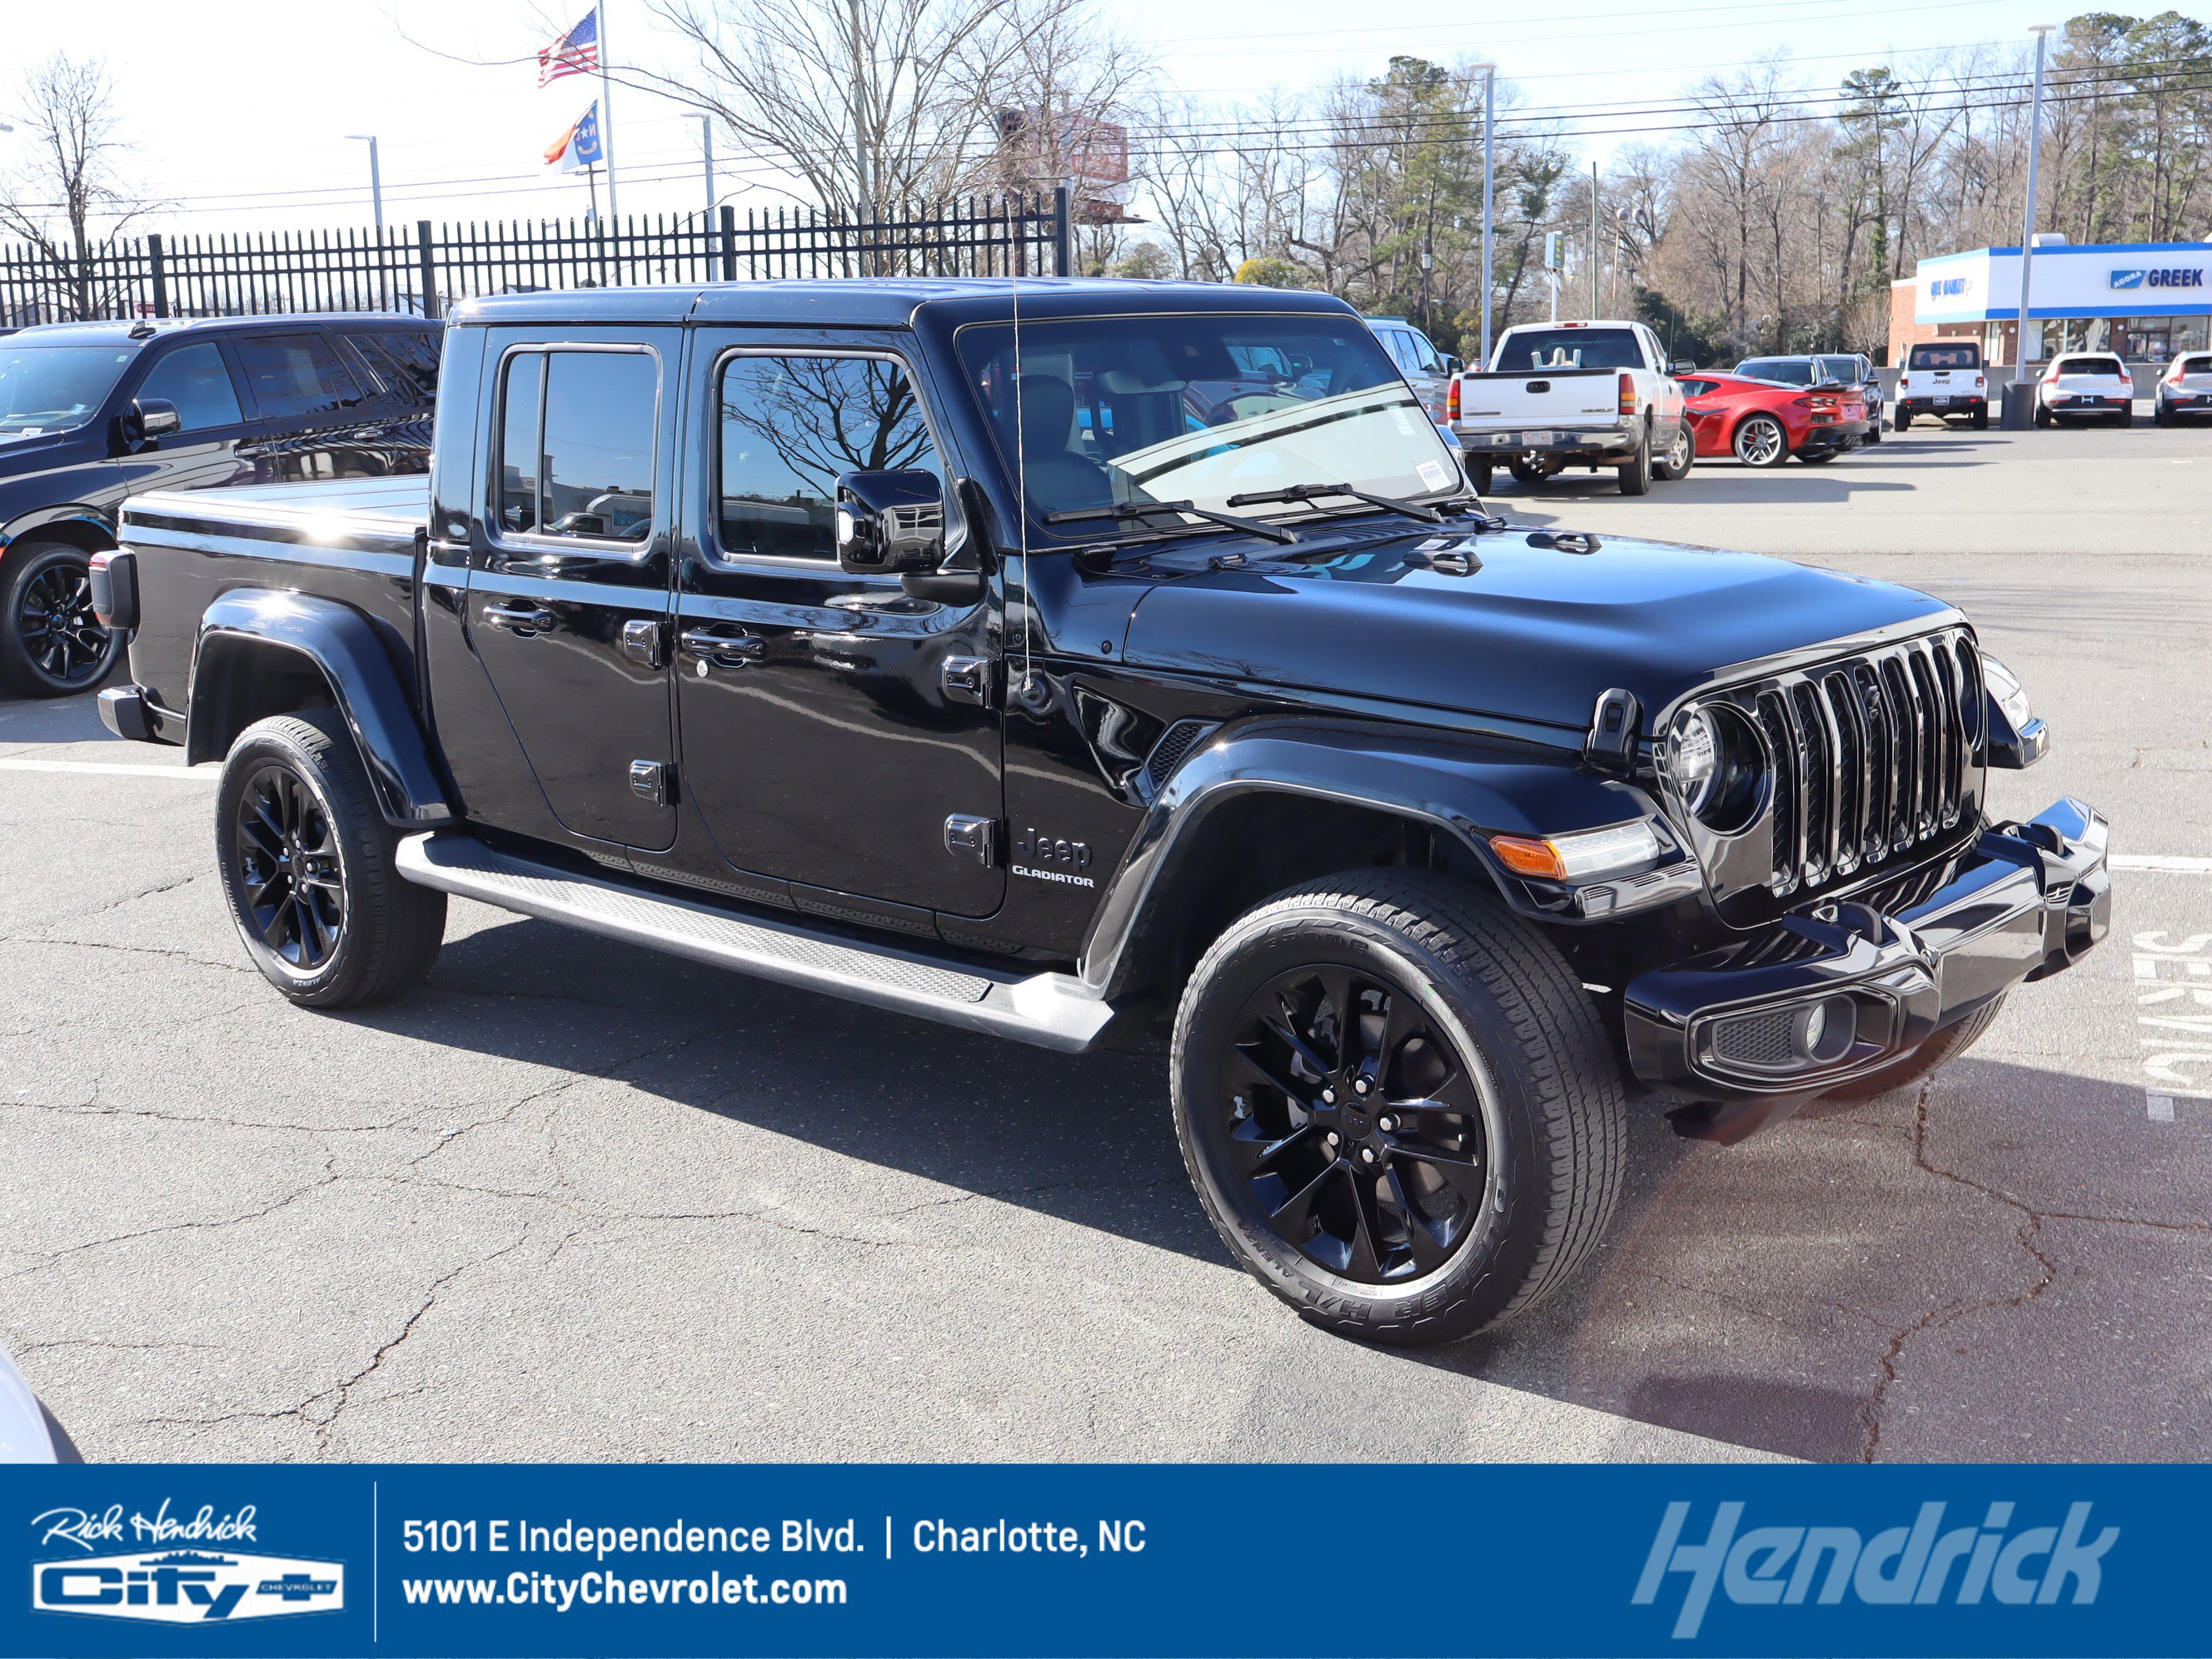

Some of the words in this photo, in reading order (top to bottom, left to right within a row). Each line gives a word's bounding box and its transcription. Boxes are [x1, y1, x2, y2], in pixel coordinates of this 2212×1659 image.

[2114, 271, 2143, 288] AGORA
[2148, 269, 2204, 287] GREEK
[1017, 827, 1093, 872] Jeep
[1012, 865, 1095, 888] GLADIATOR
[1236, 1219, 1294, 1278] ALENZA
[1298, 1280, 1373, 1320] H/L
